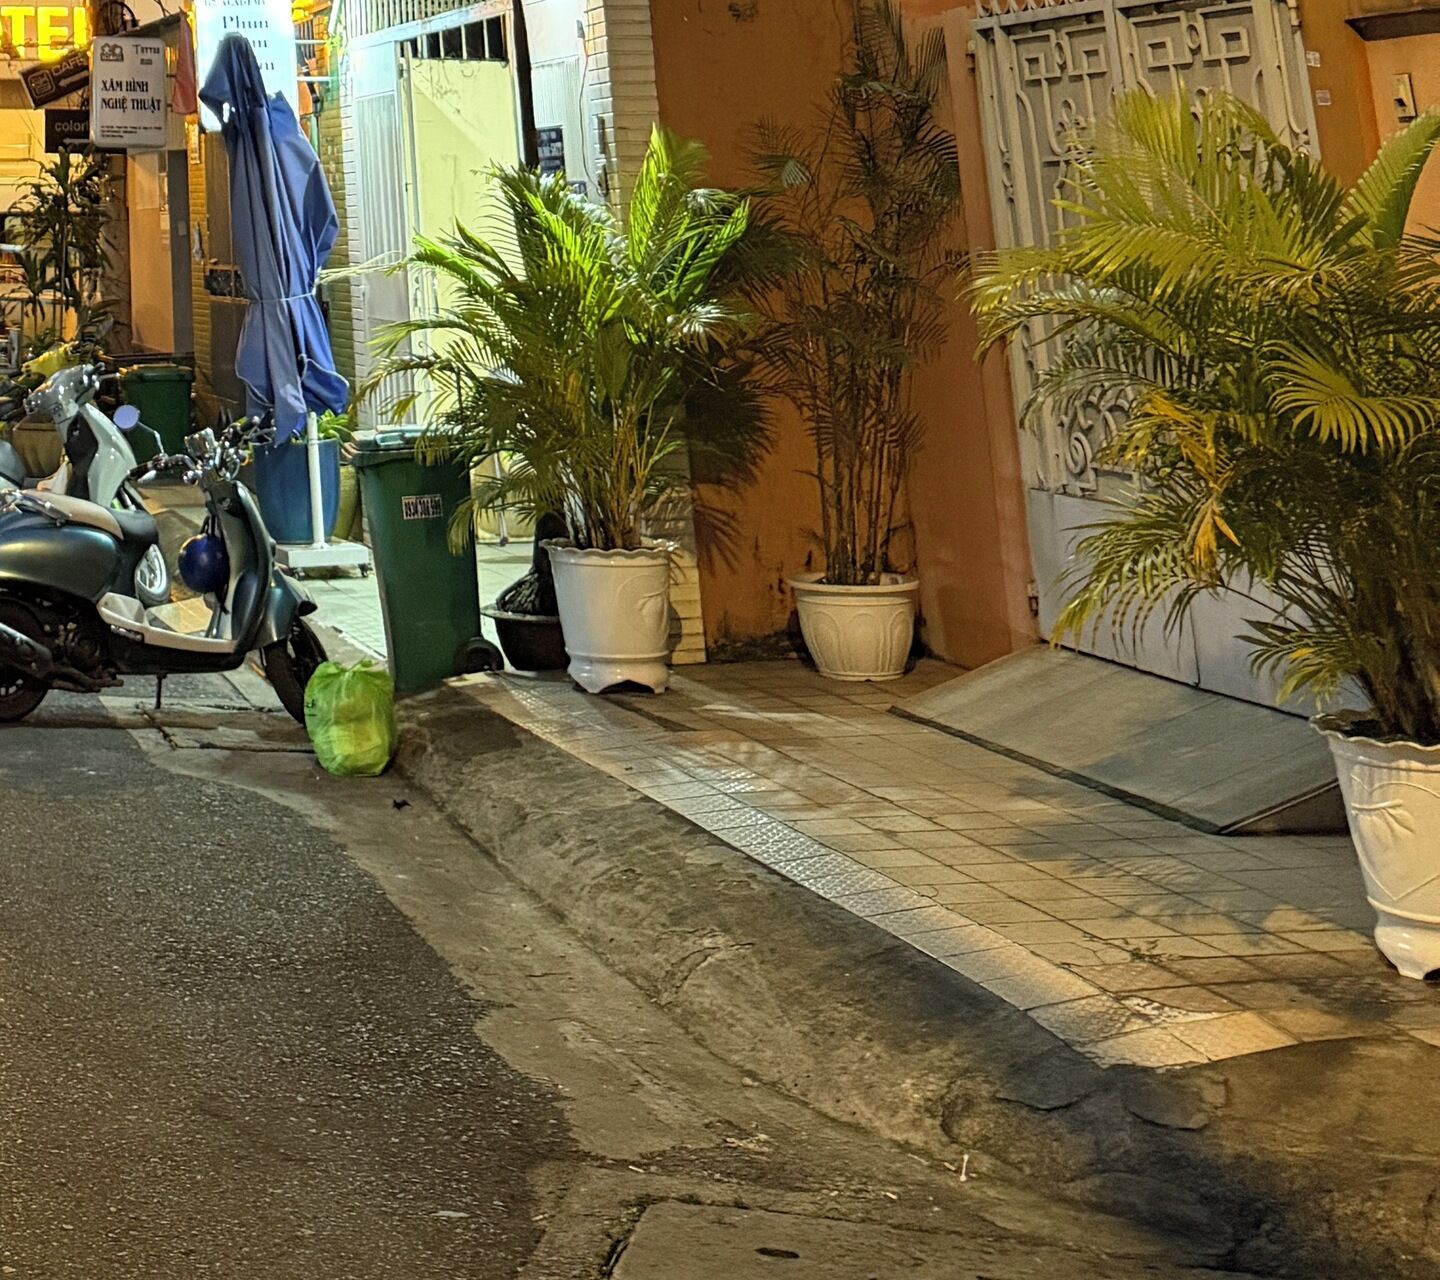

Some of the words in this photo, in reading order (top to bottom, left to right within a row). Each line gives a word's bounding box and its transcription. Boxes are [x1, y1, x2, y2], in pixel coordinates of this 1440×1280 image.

[222, 15, 269, 29] Phun
[125, 76, 149, 92] HÌNH
[100, 95, 128, 114] NGHỆ
[131, 96, 162, 114] THUẬT
